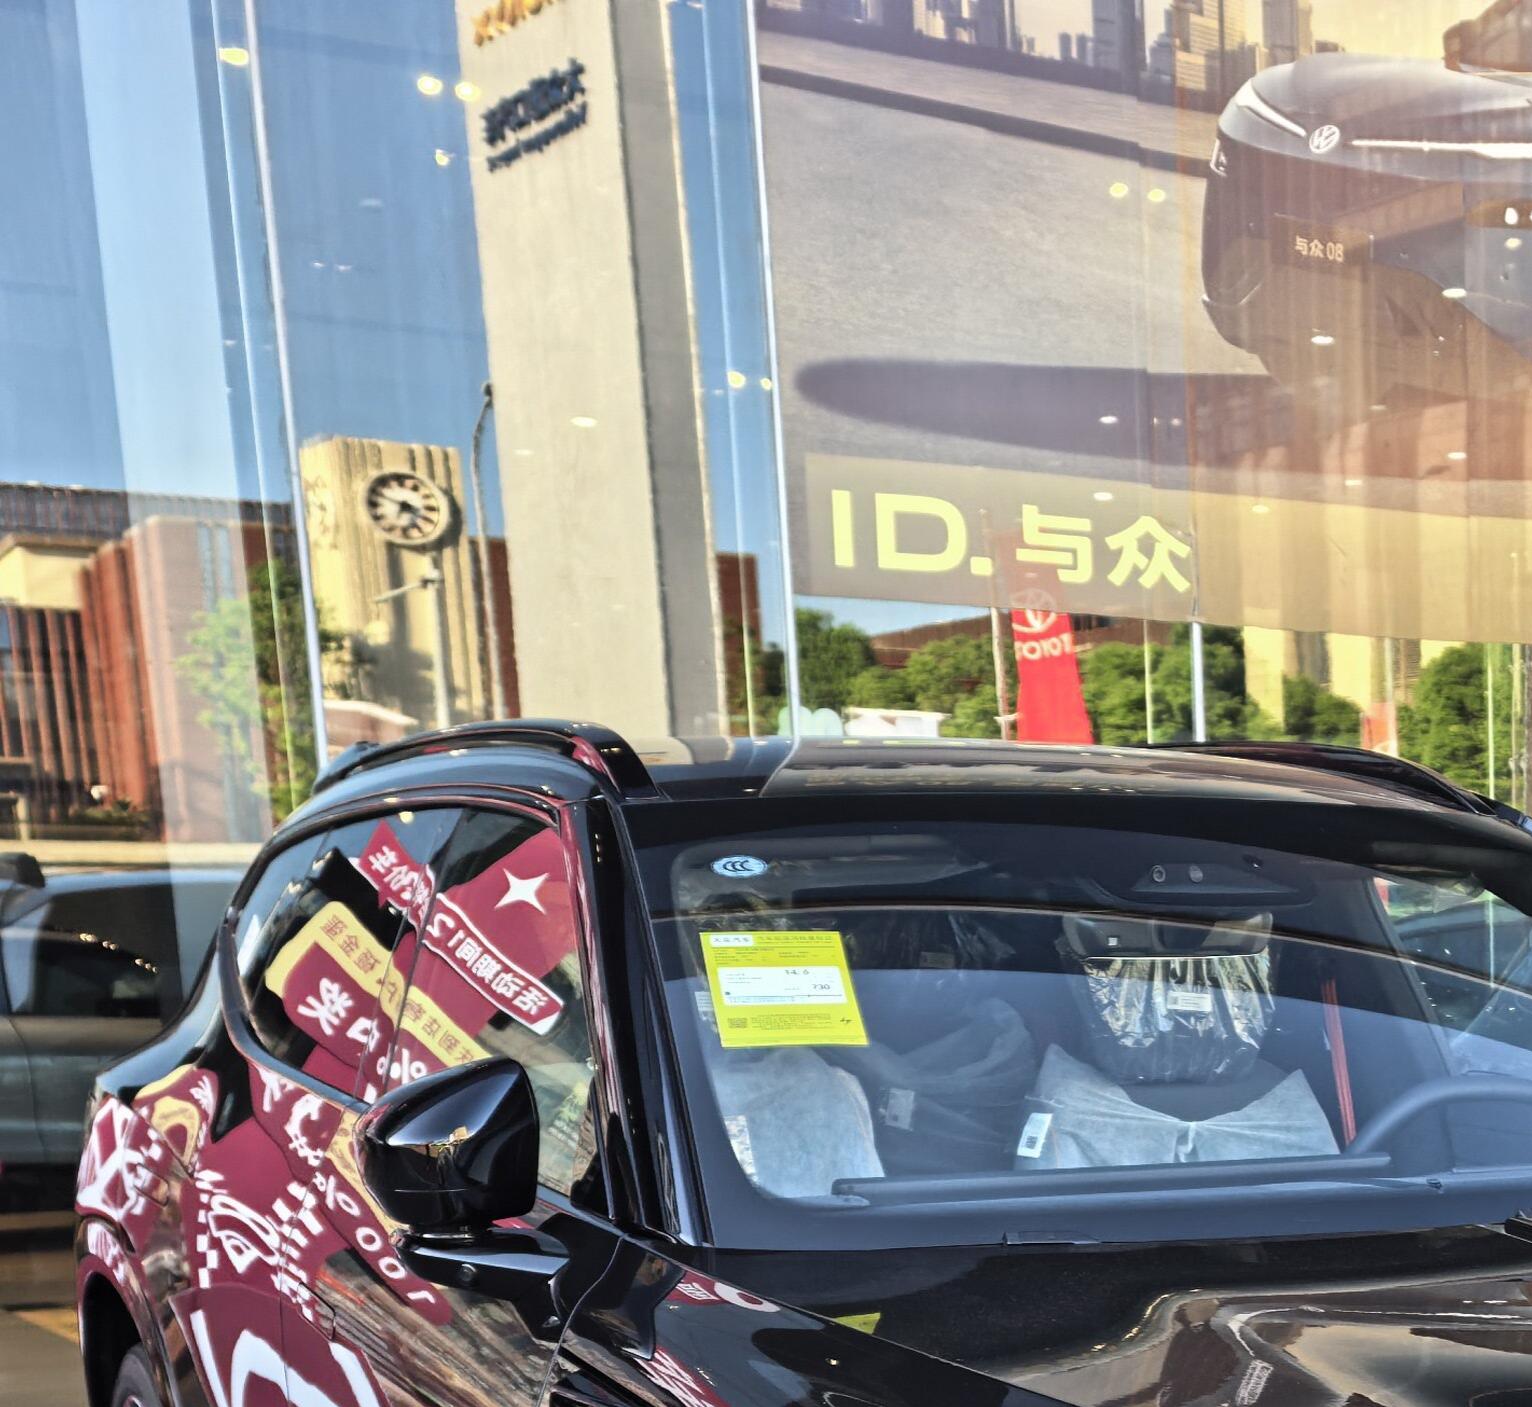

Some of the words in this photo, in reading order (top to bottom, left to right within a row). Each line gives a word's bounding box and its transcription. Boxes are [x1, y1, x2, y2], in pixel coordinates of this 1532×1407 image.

[1296, 235, 1324, 258] 与众
[1327, 241, 1345, 262] 08
[832, 489, 993, 577] ID.
[1015, 504, 1192, 593] 与众
